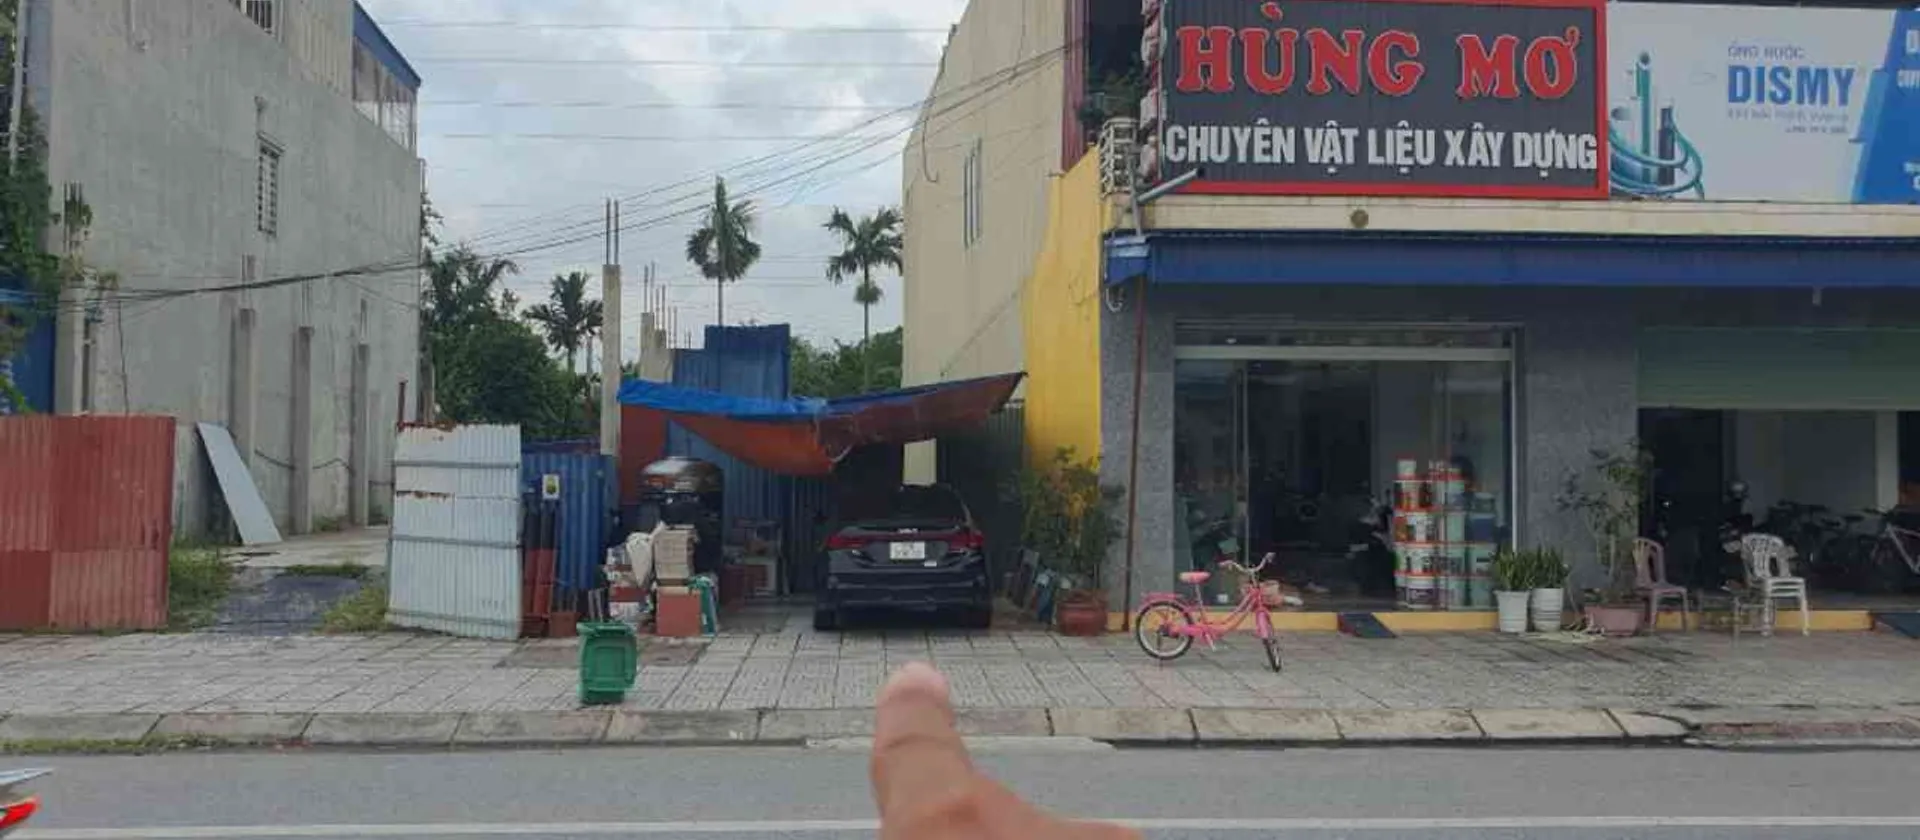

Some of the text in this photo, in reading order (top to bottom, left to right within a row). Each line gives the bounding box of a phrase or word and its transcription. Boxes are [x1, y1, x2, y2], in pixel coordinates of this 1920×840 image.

[1176, 1, 1581, 99] HÙNG MƠ
[1728, 65, 1855, 107] DISMY
[1166, 117, 1598, 177] CHUYÊN VẬT LIỆU XÂY DỰNG
